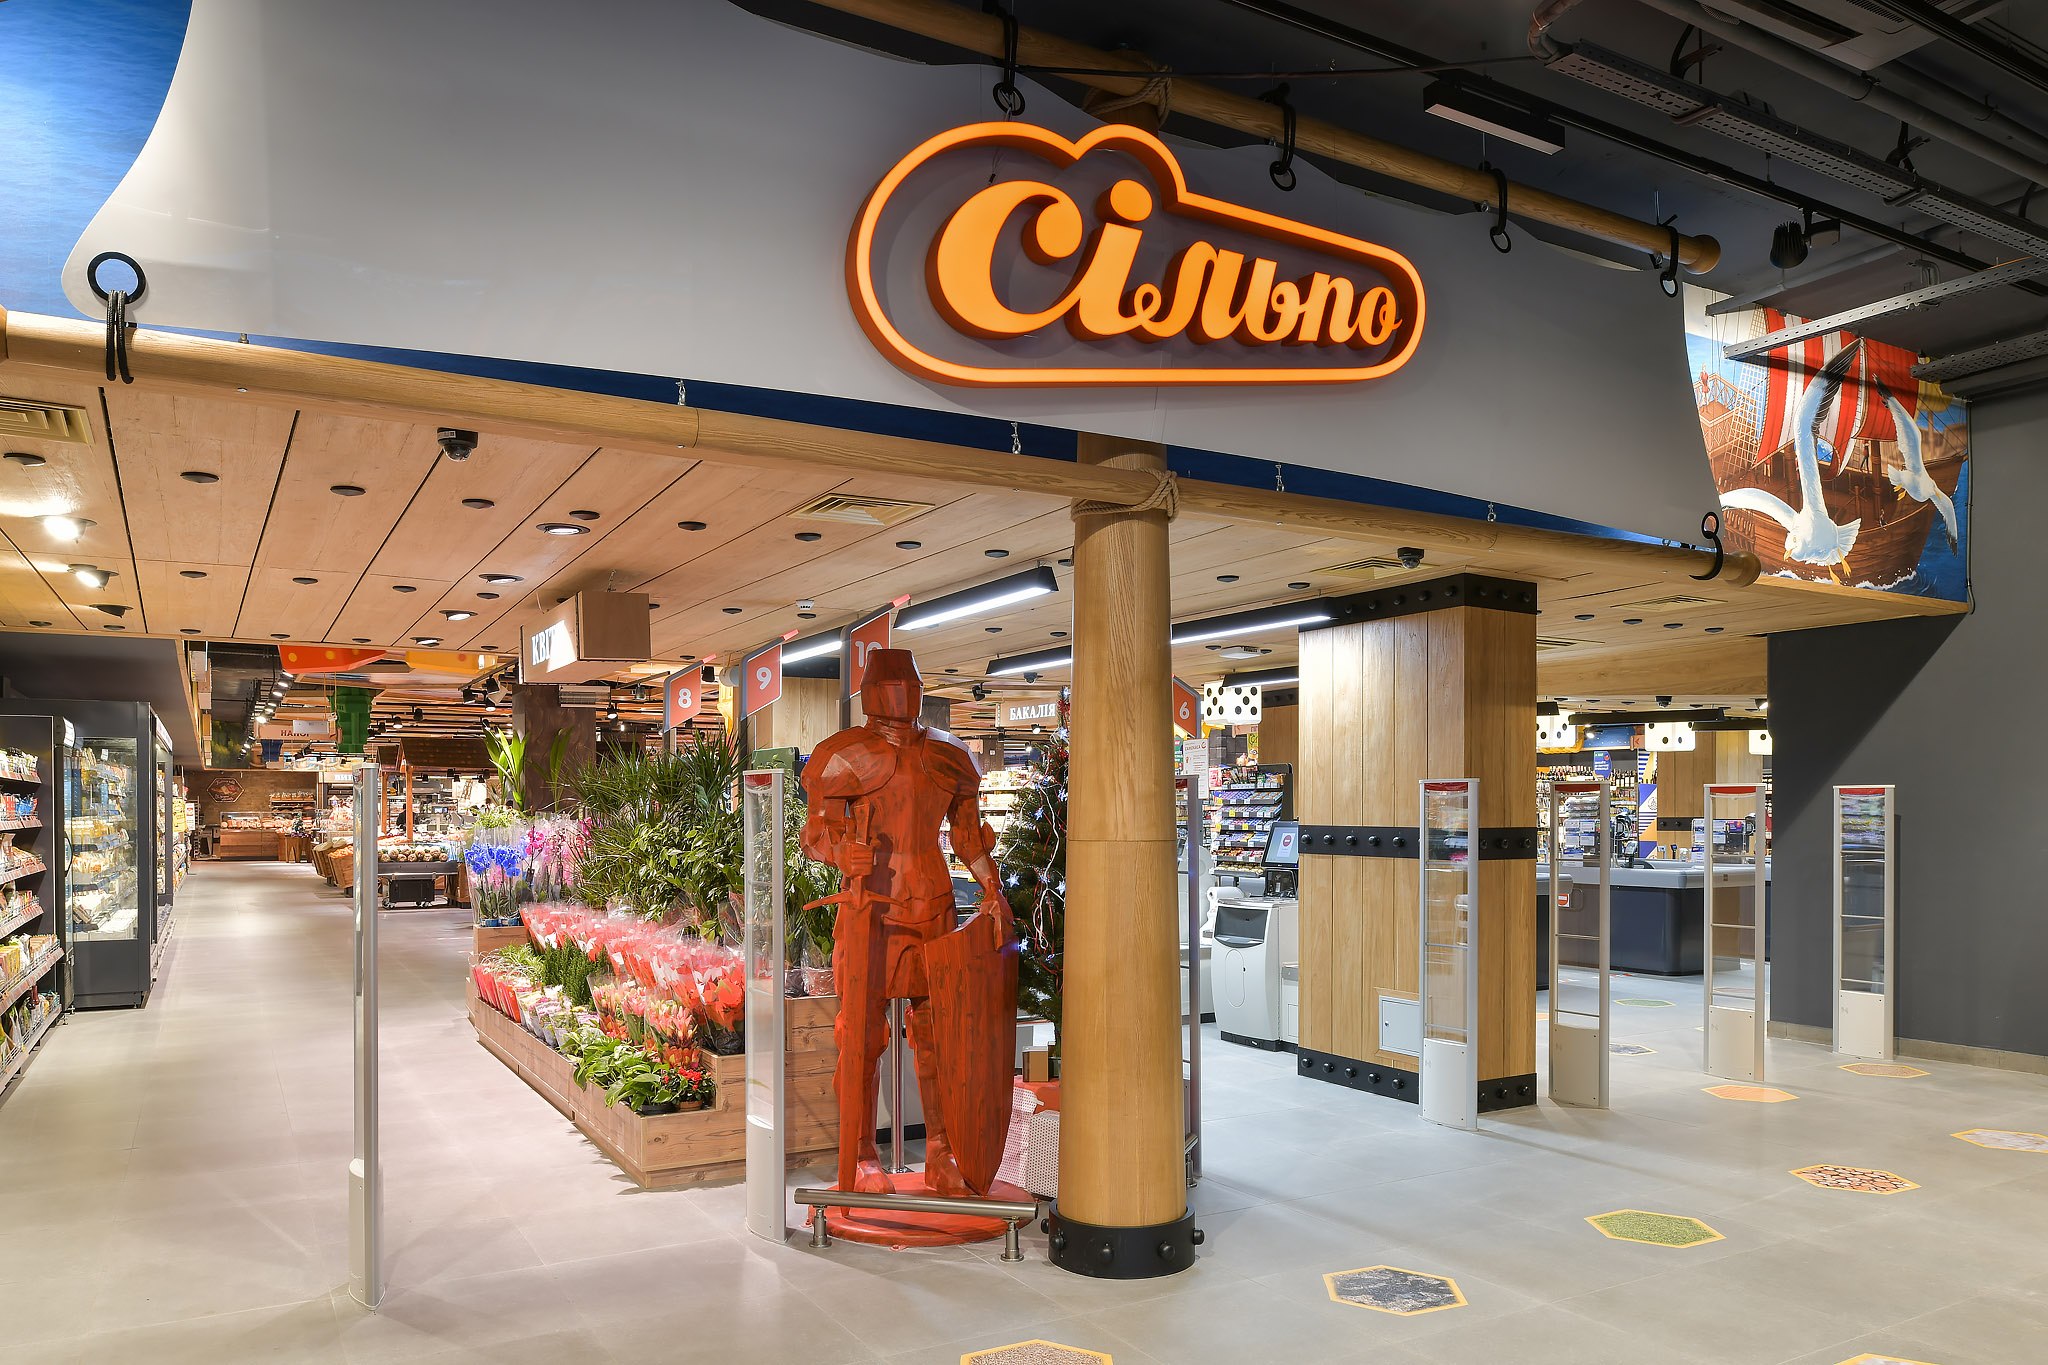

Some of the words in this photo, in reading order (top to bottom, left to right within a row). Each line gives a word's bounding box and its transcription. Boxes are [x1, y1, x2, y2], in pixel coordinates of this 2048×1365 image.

[932, 179, 1403, 347] Сільпо
[854, 640, 883, 668] 1
[756, 666, 772, 690] 9
[677, 688, 692, 709] 8
[1009, 703, 1056, 721] БАКАЛІЯ
[1179, 701, 1190, 720] 6
